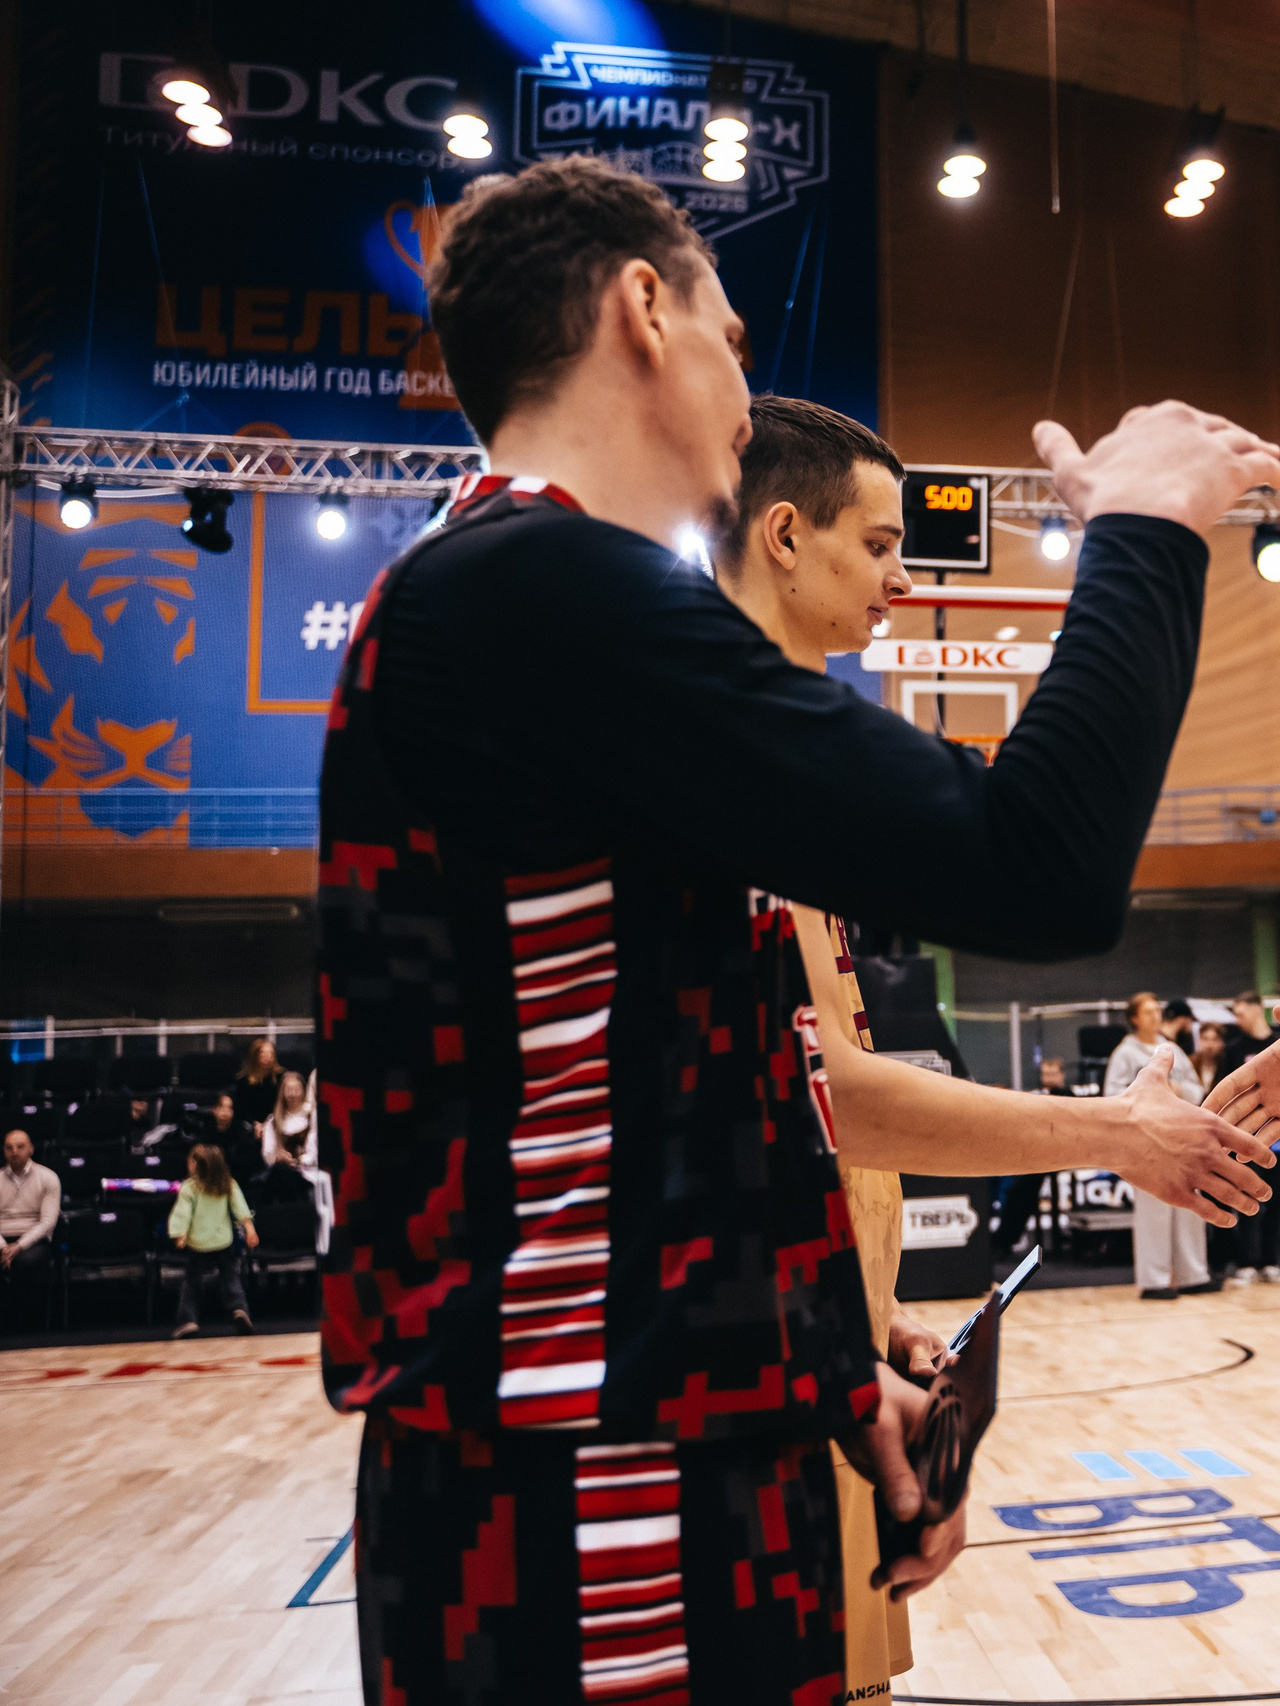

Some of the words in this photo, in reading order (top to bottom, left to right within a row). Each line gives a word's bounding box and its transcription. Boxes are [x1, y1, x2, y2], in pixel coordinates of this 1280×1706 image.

[543, 96, 712, 131] ФИНАЛ
[104, 126, 298, 157] Титуный
[155, 283, 423, 356] ЦЕЛЬ
[153, 360, 317, 392] ЮБИЛЕЙНЫЙ
[324, 367, 373, 397] ГОД
[377, 368, 455, 398] БАСКЕ
